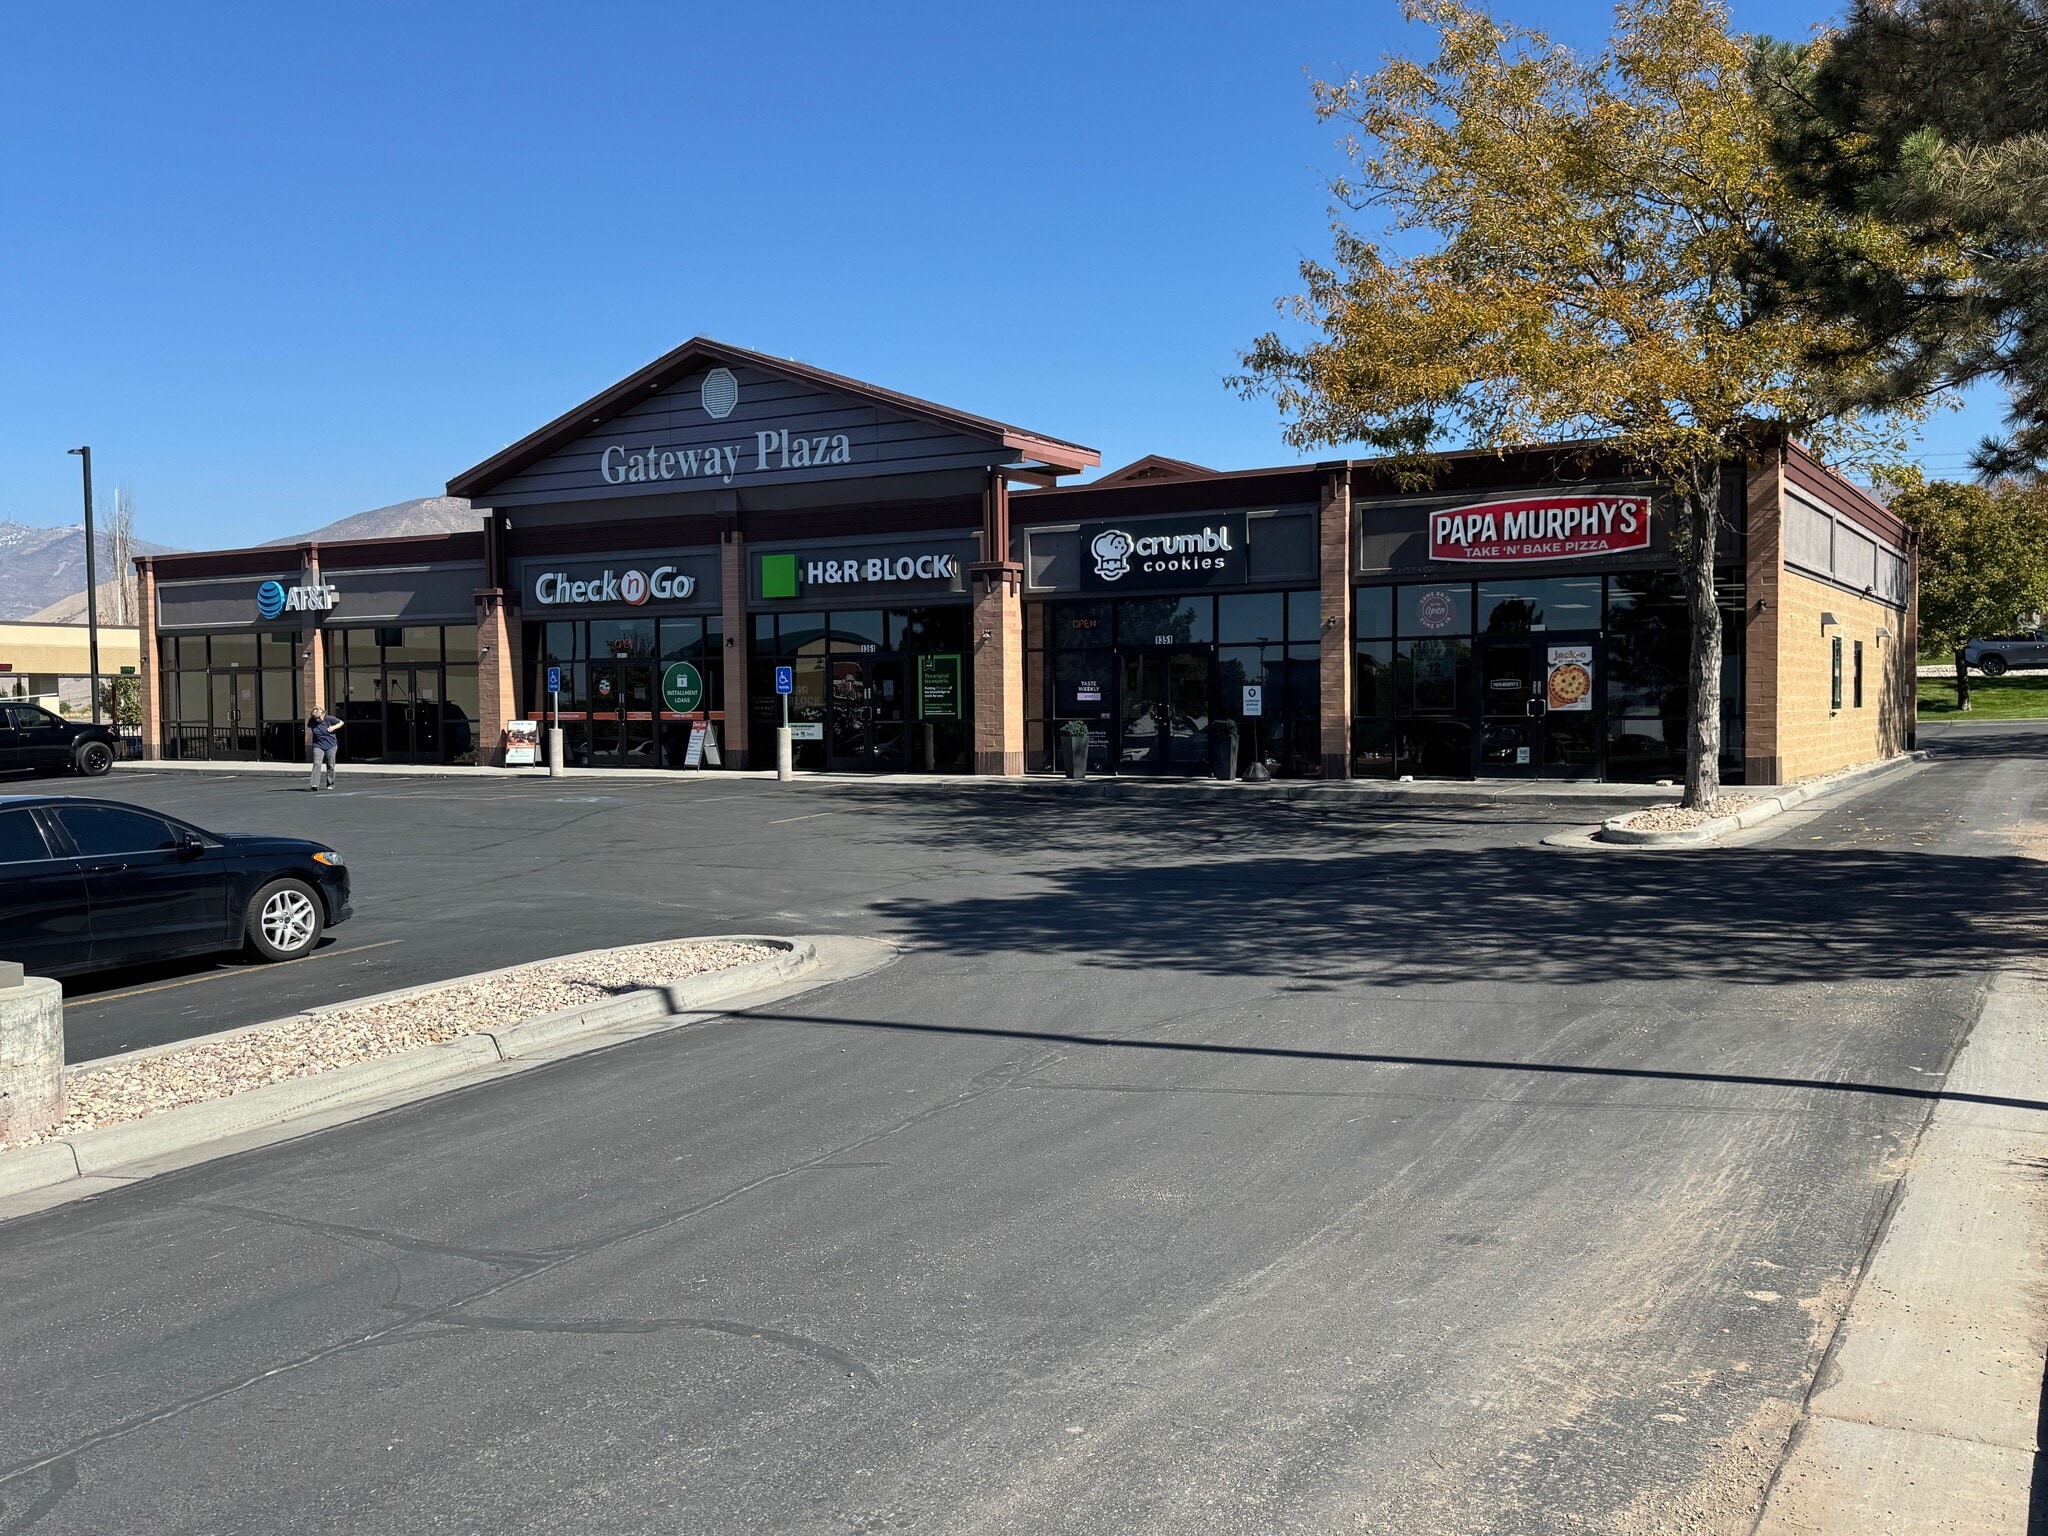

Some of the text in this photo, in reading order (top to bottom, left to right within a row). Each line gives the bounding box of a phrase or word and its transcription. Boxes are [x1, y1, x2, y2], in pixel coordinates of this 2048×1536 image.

[601, 429, 852, 484] Gateway Plaza
[1436, 500, 1638, 547] PAPA MURPHY'S
[1136, 526, 1232, 556] crumbl
[1464, 546, 1500, 558] TAKE
[1523, 542, 1562, 554] BAKE
[1565, 539, 1609, 552] PIZZA
[807, 554, 953, 585] H&R BLOCK
[1143, 556, 1225, 573] cookies
[285, 585, 336, 612] AT&T
[535, 570, 619, 605] Check
[650, 566, 693, 599] Go
[1072, 619, 1097, 629] OPEN
[1425, 606, 1446, 618] Open
